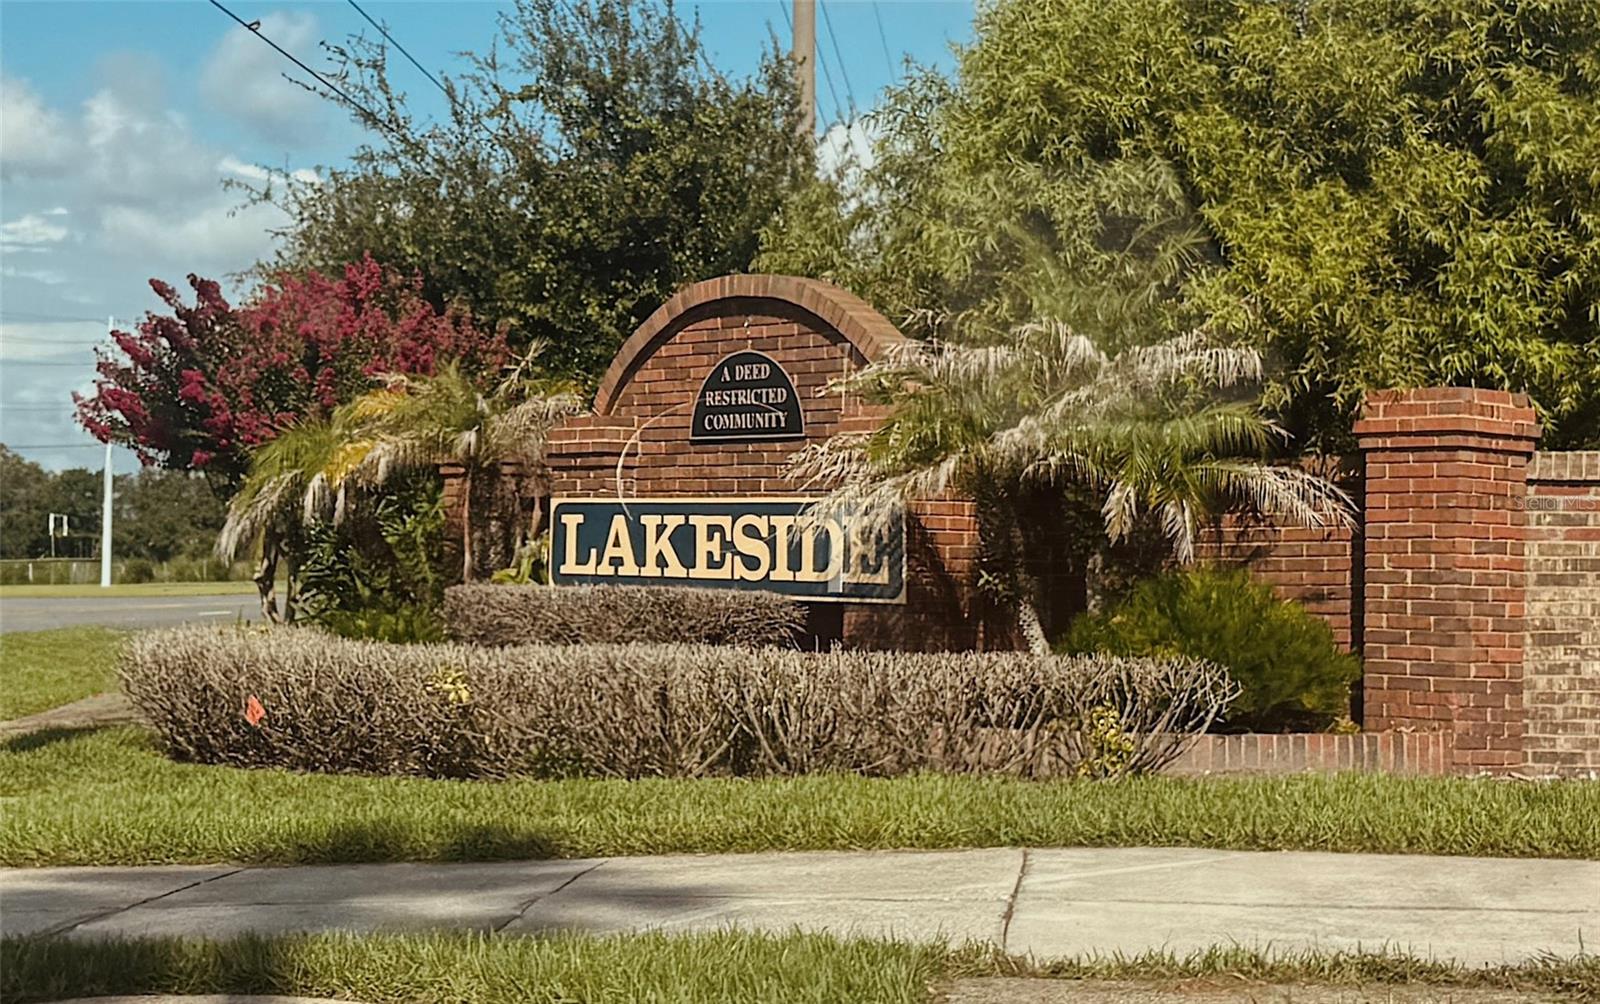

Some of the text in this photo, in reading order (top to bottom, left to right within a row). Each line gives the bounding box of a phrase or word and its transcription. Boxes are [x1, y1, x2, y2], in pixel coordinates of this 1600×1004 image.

[721, 364, 771, 382] A DEED
[705, 388, 787, 406] RESTRICTED
[704, 412, 787, 430] COMMUNITY
[559, 514, 889, 585] LAKESIDE
